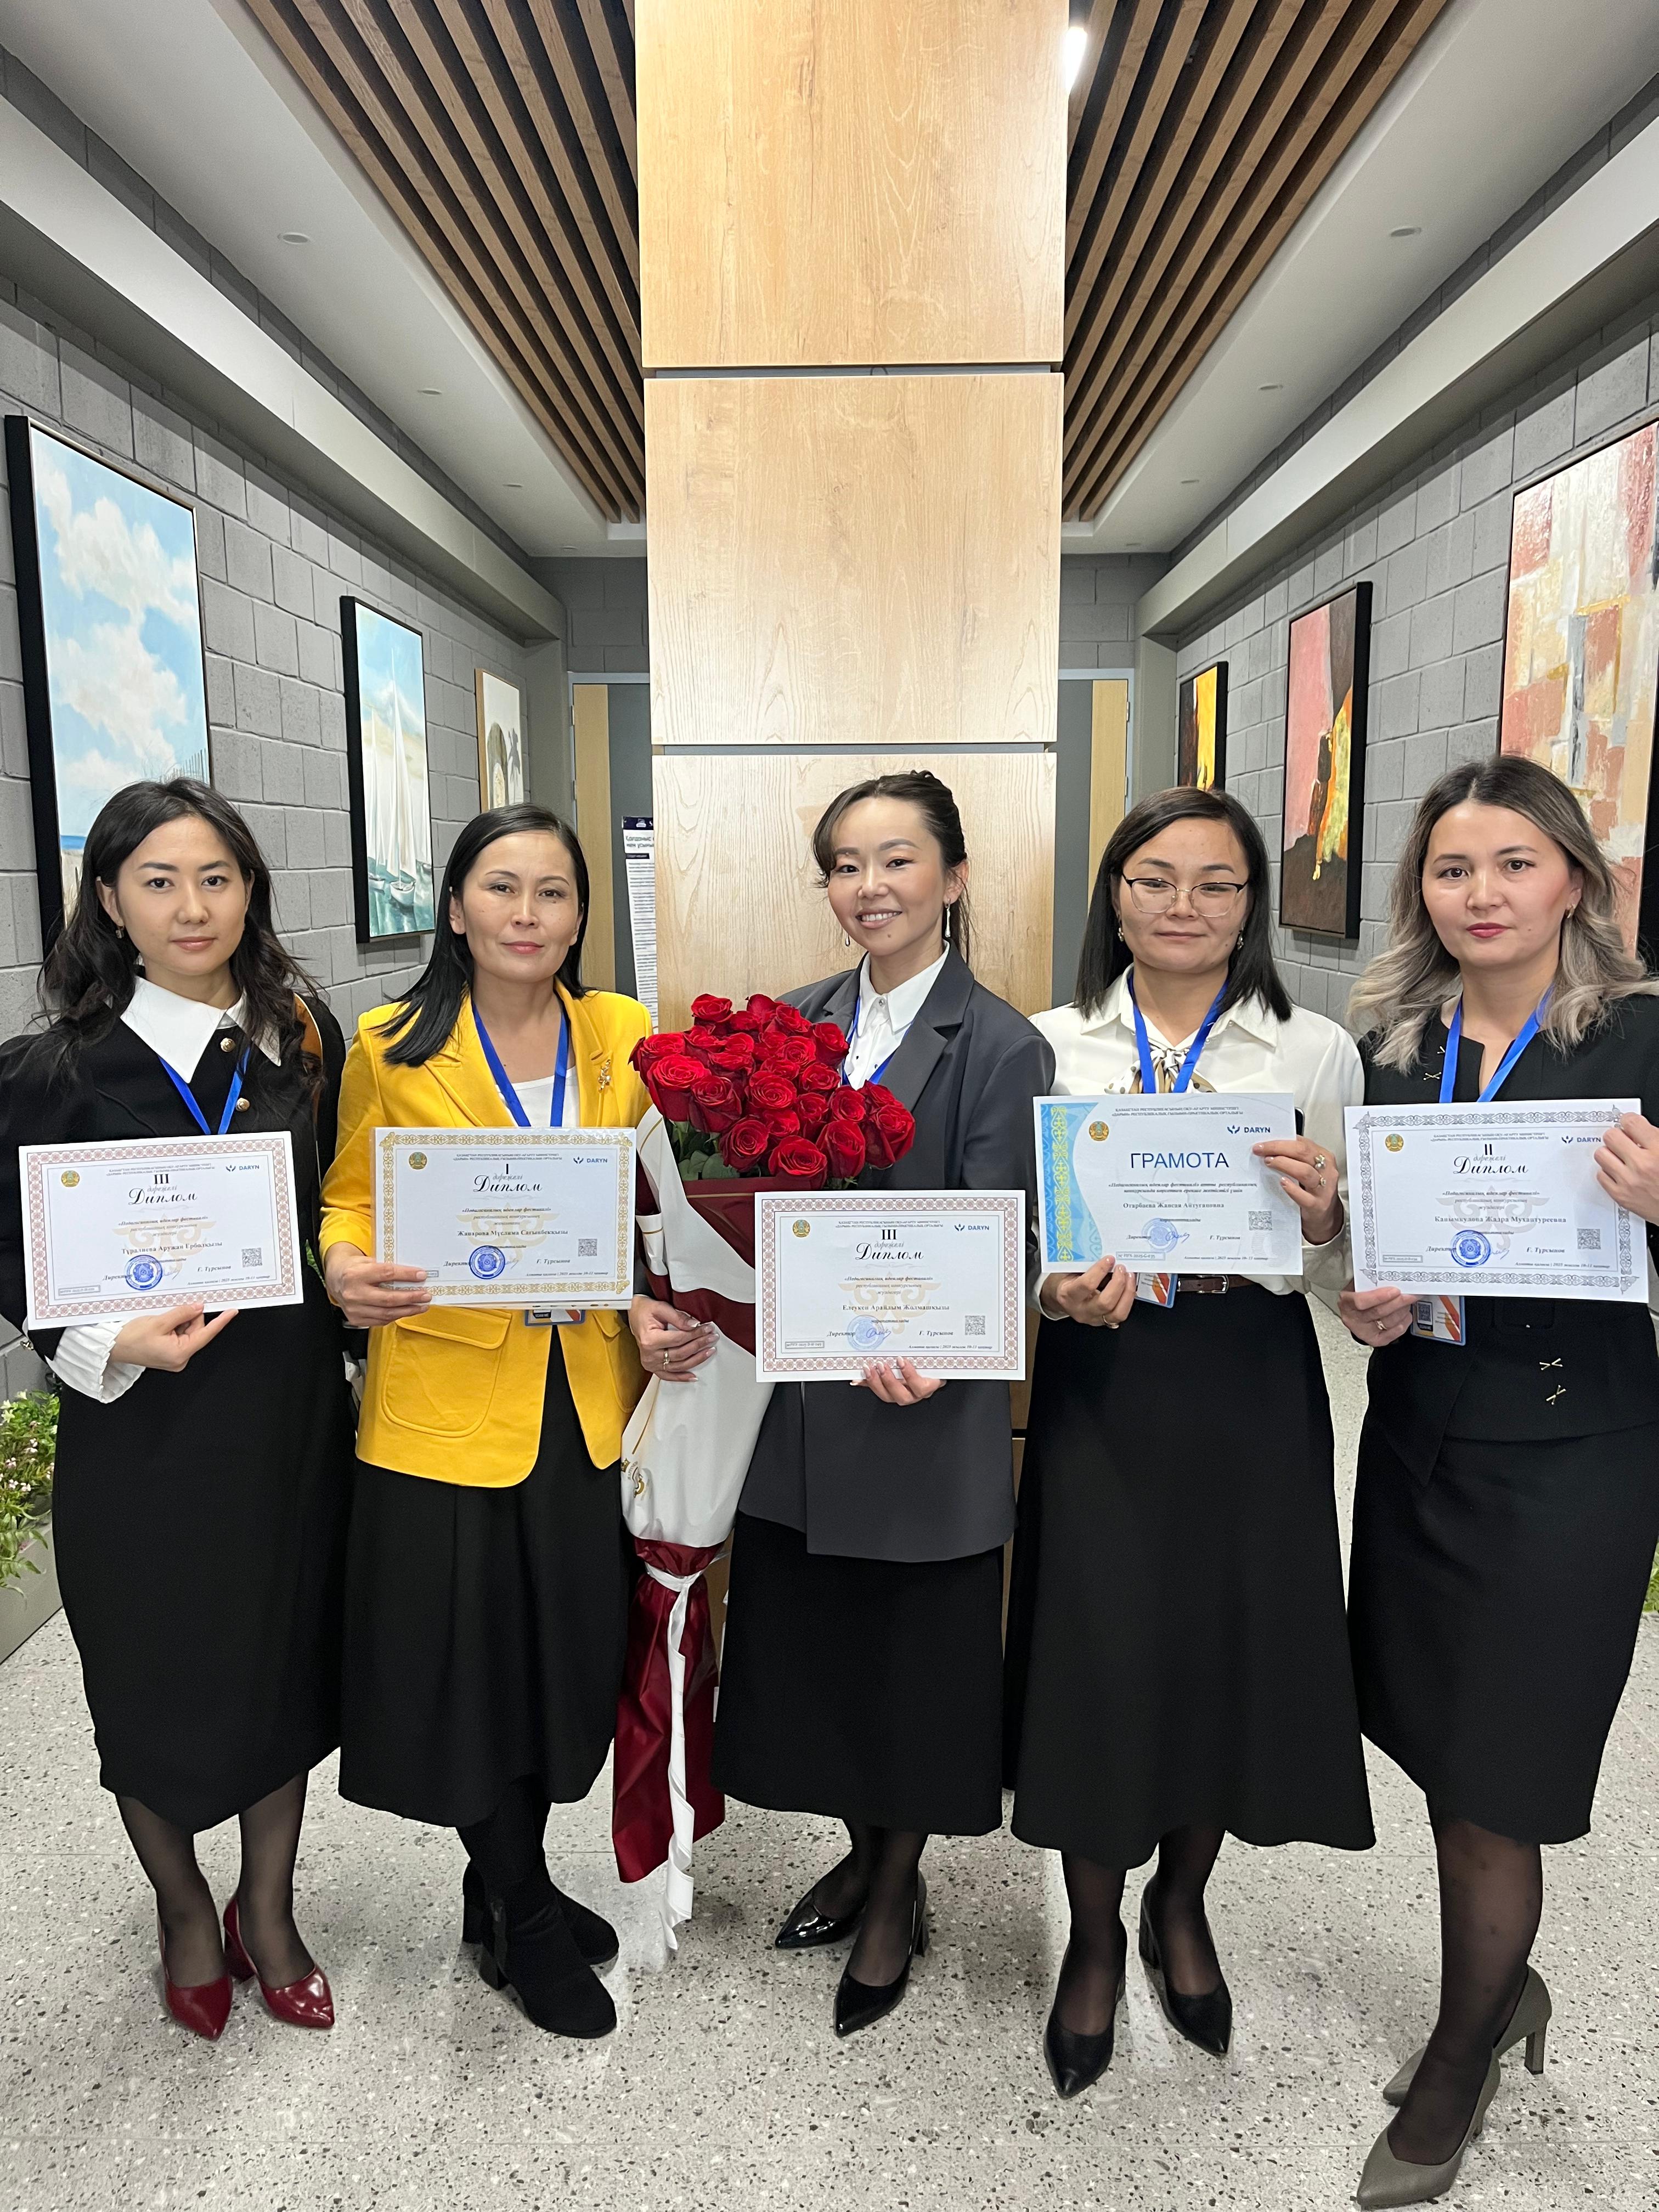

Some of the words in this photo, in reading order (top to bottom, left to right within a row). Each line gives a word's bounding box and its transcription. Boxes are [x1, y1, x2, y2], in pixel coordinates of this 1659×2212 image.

[1485, 1144, 1492, 1155] II
[1131, 1152, 1229, 1168] ГРАМОТА
[1453, 1156, 1528, 1174] Диплом
[506, 1164, 509, 1174] I
[154, 1173, 169, 1184] III
[473, 1175, 542, 1192] Диплом
[128, 1188, 197, 1205] Диплом
[881, 1229, 897, 1240] III
[855, 1242, 924, 1260] Диплом
